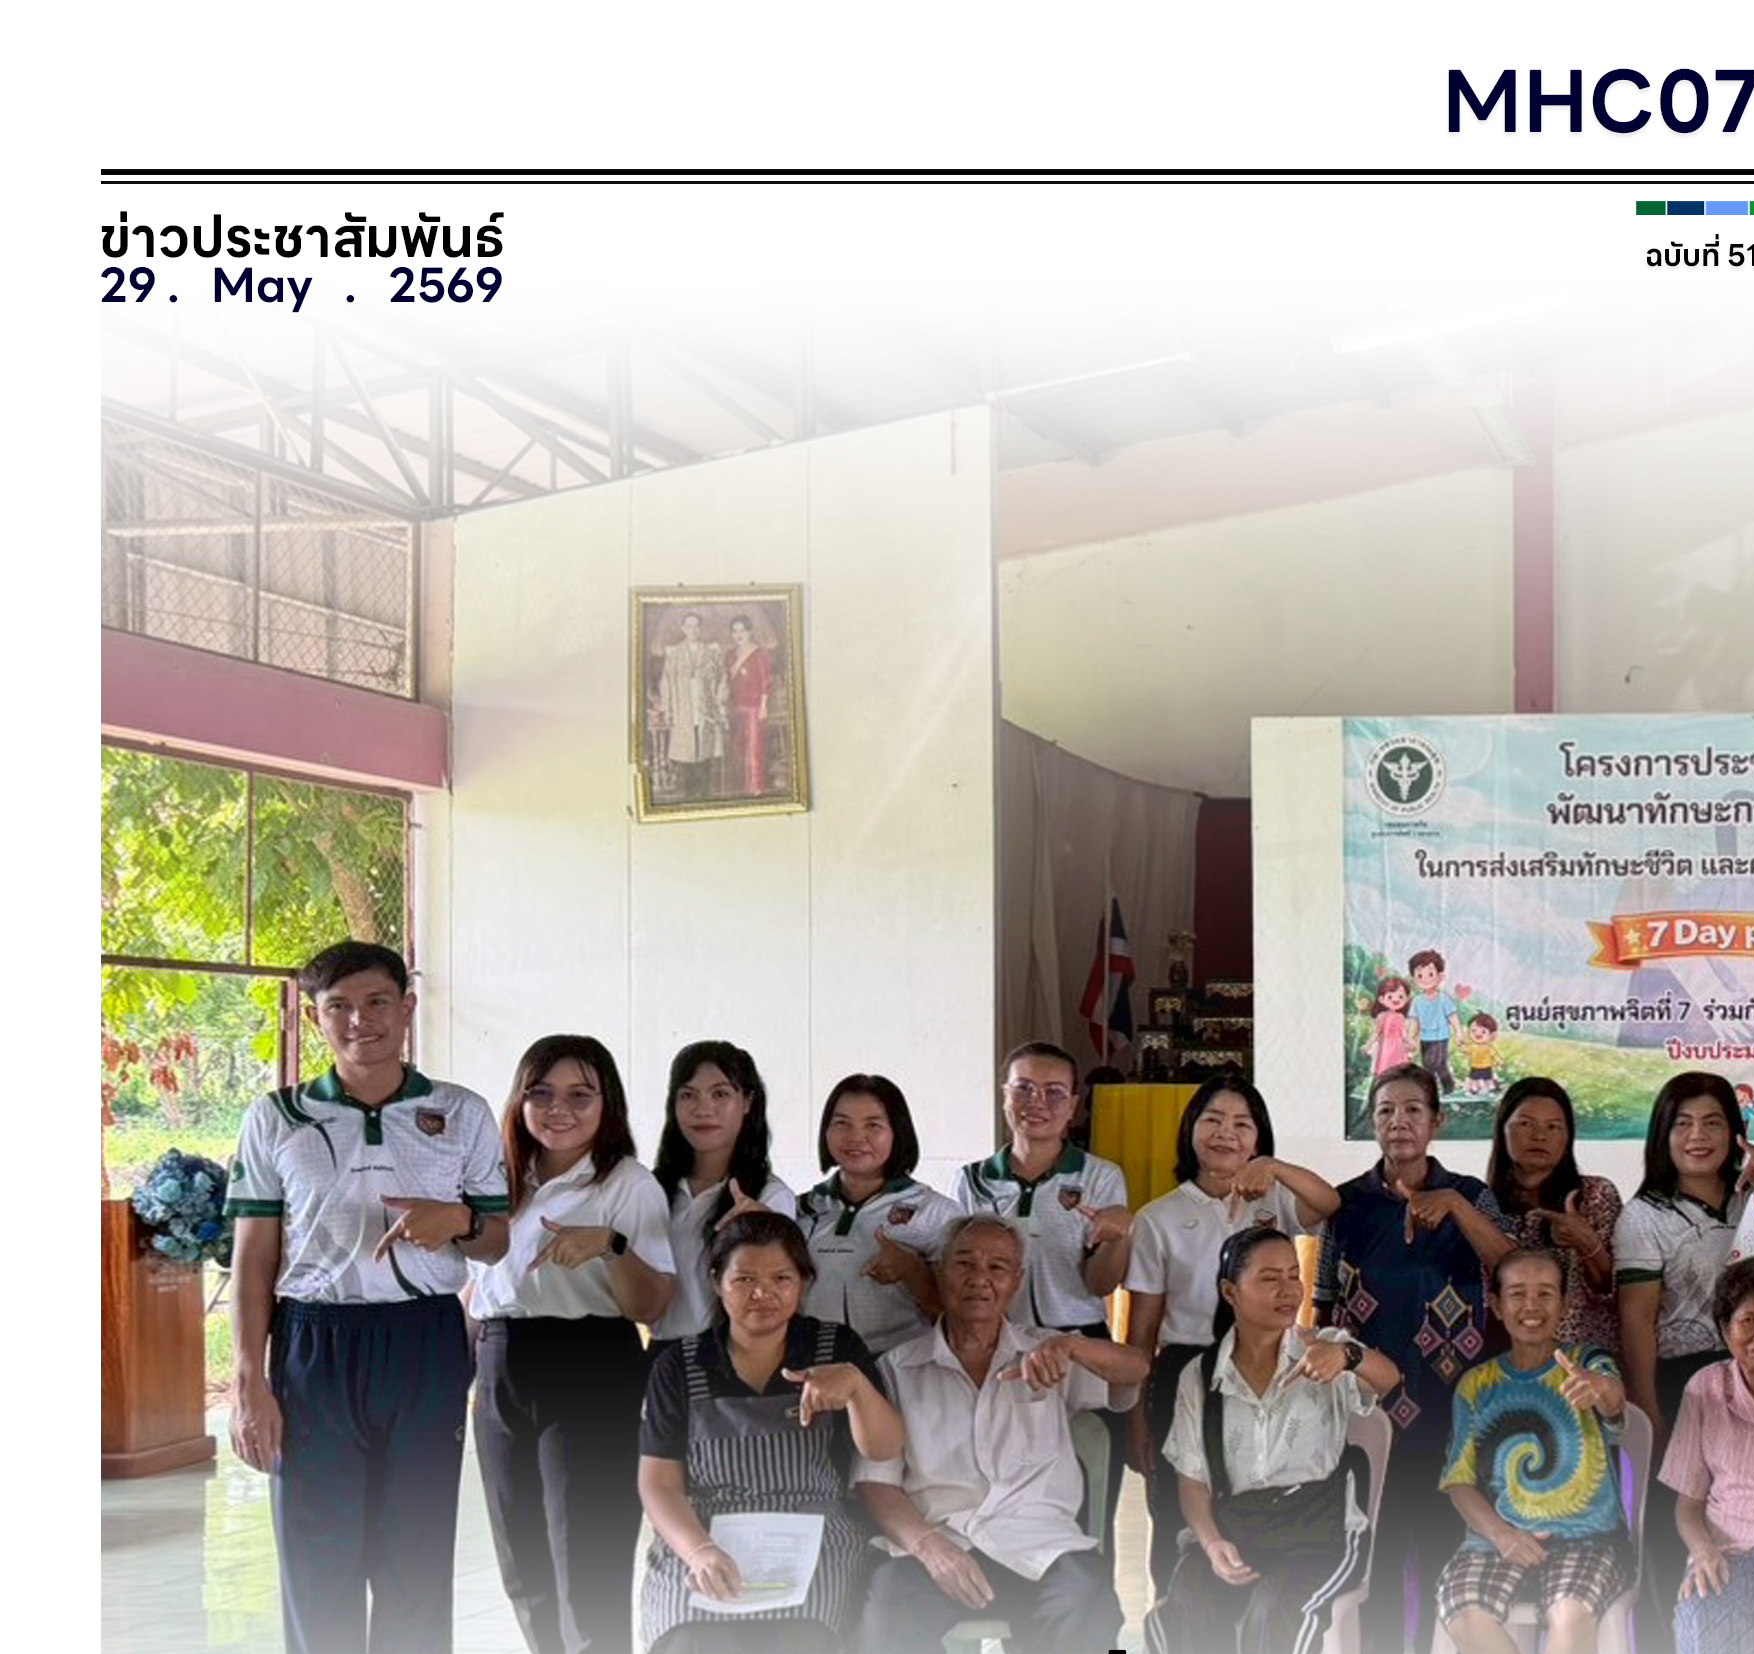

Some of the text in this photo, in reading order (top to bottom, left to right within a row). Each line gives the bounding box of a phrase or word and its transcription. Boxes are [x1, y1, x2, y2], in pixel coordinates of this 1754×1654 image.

[1415, 850, 1694, 880] ในการส่งเสริมทักษะชีวิต
[1648, 921, 1667, 946] 7
[1673, 920, 1737, 950] Day
[1505, 993, 1673, 1025] ศูนย์สุขภาพจิตที่
[1677, 1001, 1691, 1021] 7
